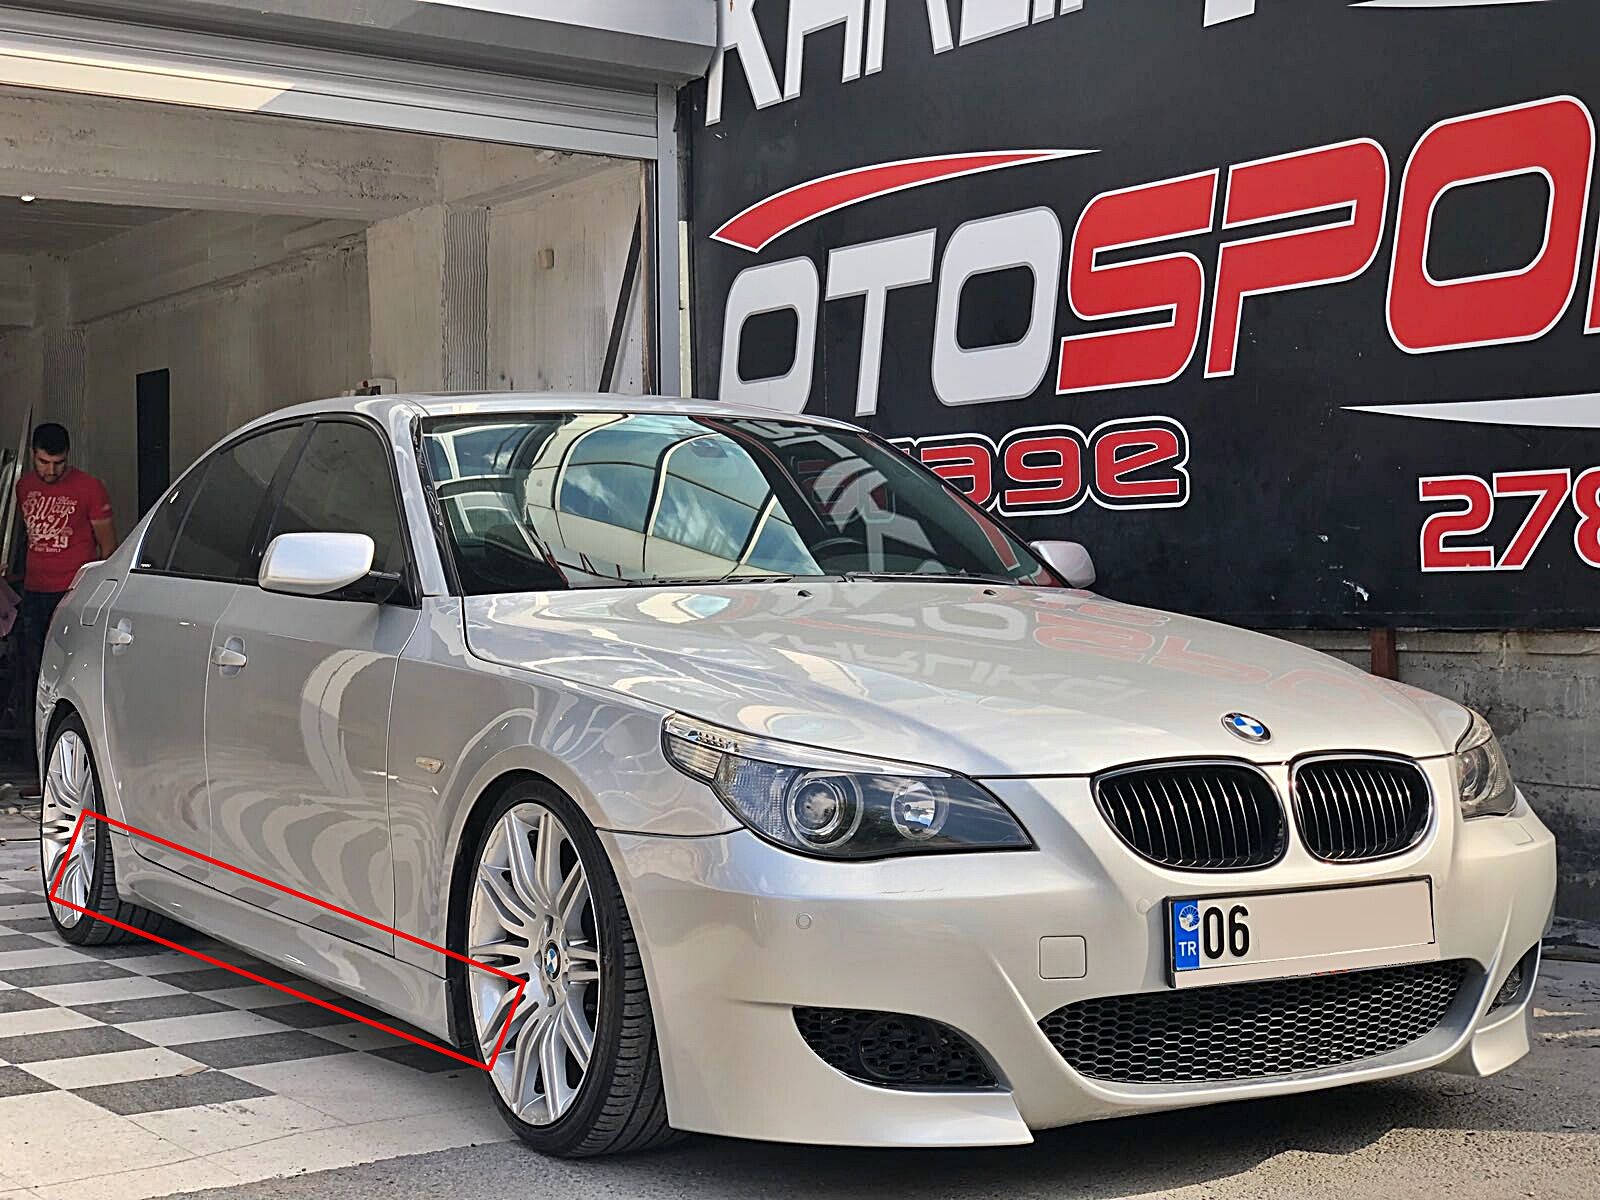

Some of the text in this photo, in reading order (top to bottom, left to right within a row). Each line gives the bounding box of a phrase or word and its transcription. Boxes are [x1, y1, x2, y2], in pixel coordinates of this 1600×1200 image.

[717, 94, 1600, 417] OTOSPO
[887, 415, 1190, 517] age
[1178, 904, 1250, 960] TR 06
